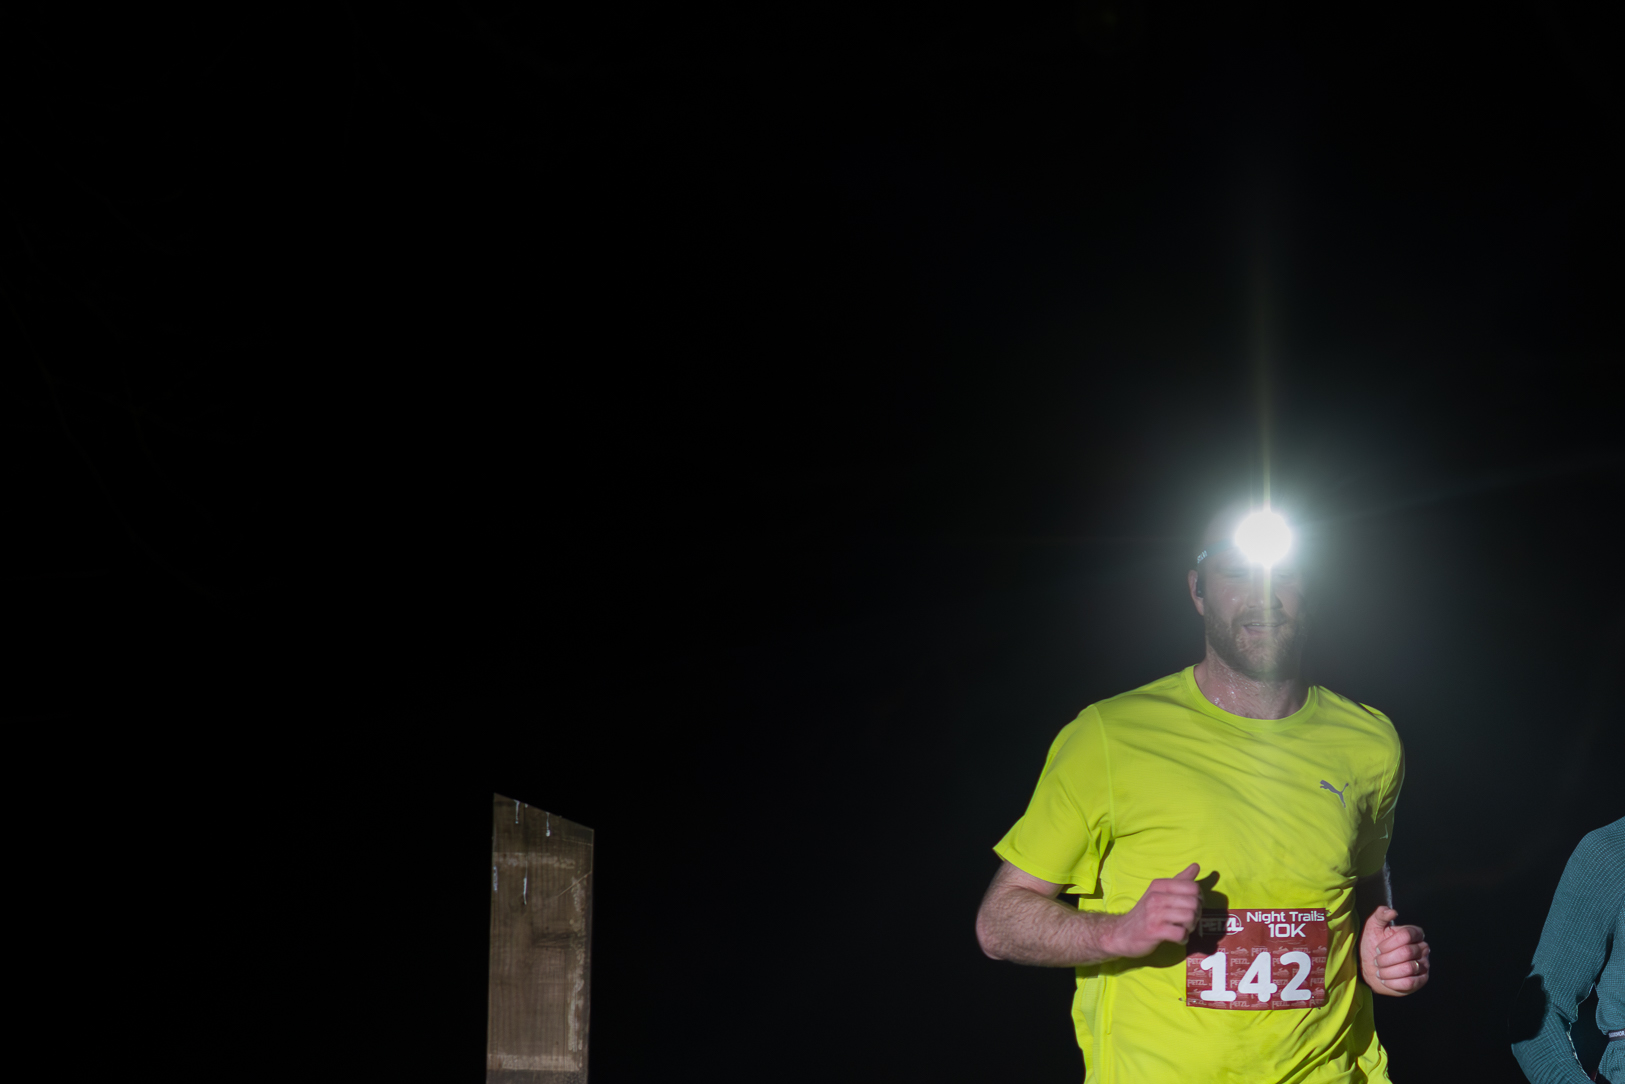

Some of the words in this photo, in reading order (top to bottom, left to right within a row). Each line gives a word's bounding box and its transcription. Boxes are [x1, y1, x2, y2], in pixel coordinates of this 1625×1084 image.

[1246, 911, 1286, 924] Night
[1289, 911, 1326, 922] Trails
[1268, 923, 1306, 938] 10K
[1200, 951, 1312, 1002] 142
